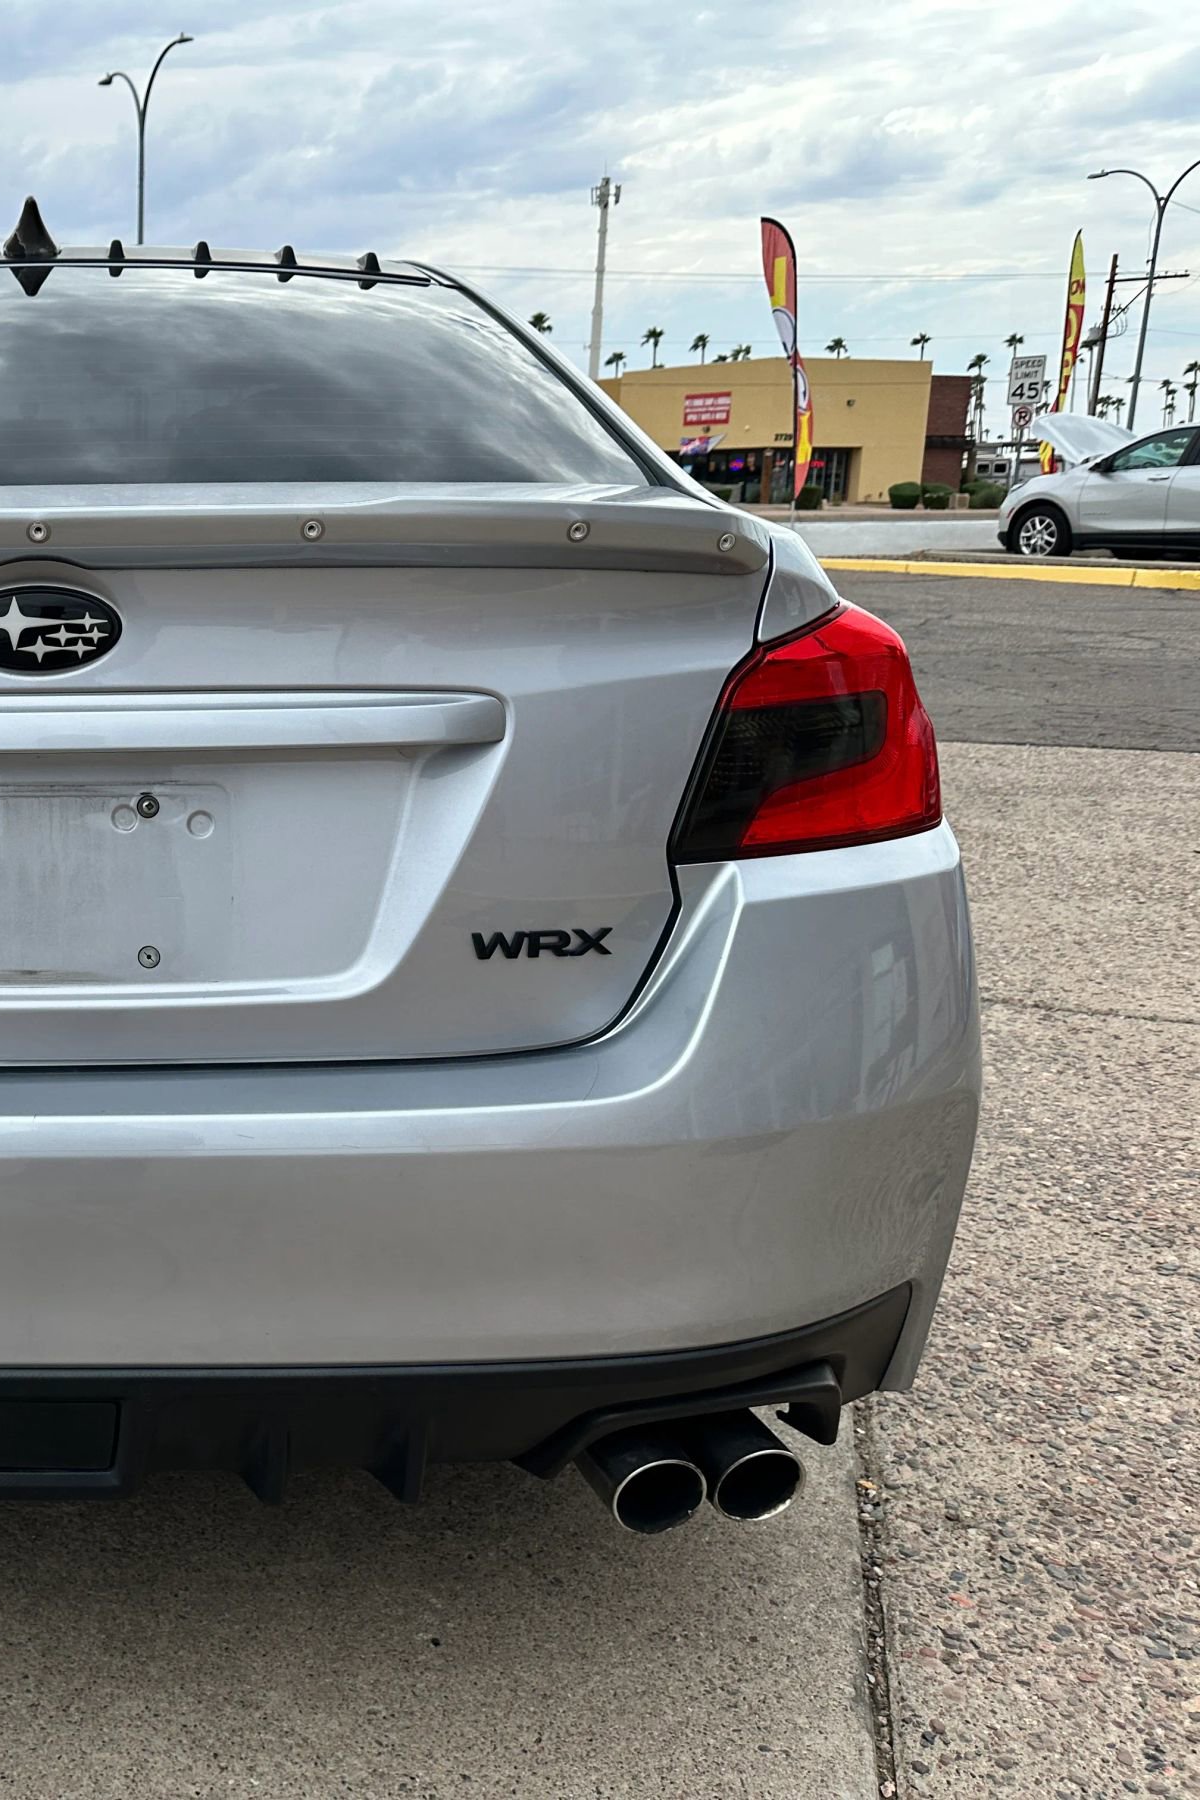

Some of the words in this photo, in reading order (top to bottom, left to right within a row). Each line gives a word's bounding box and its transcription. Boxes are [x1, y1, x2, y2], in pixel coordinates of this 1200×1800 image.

[1014, 359, 1043, 369] SPEED
[1014, 370, 1039, 380] LIMIT
[1011, 381, 1040, 400] 45
[471, 927, 614, 960] WRX
